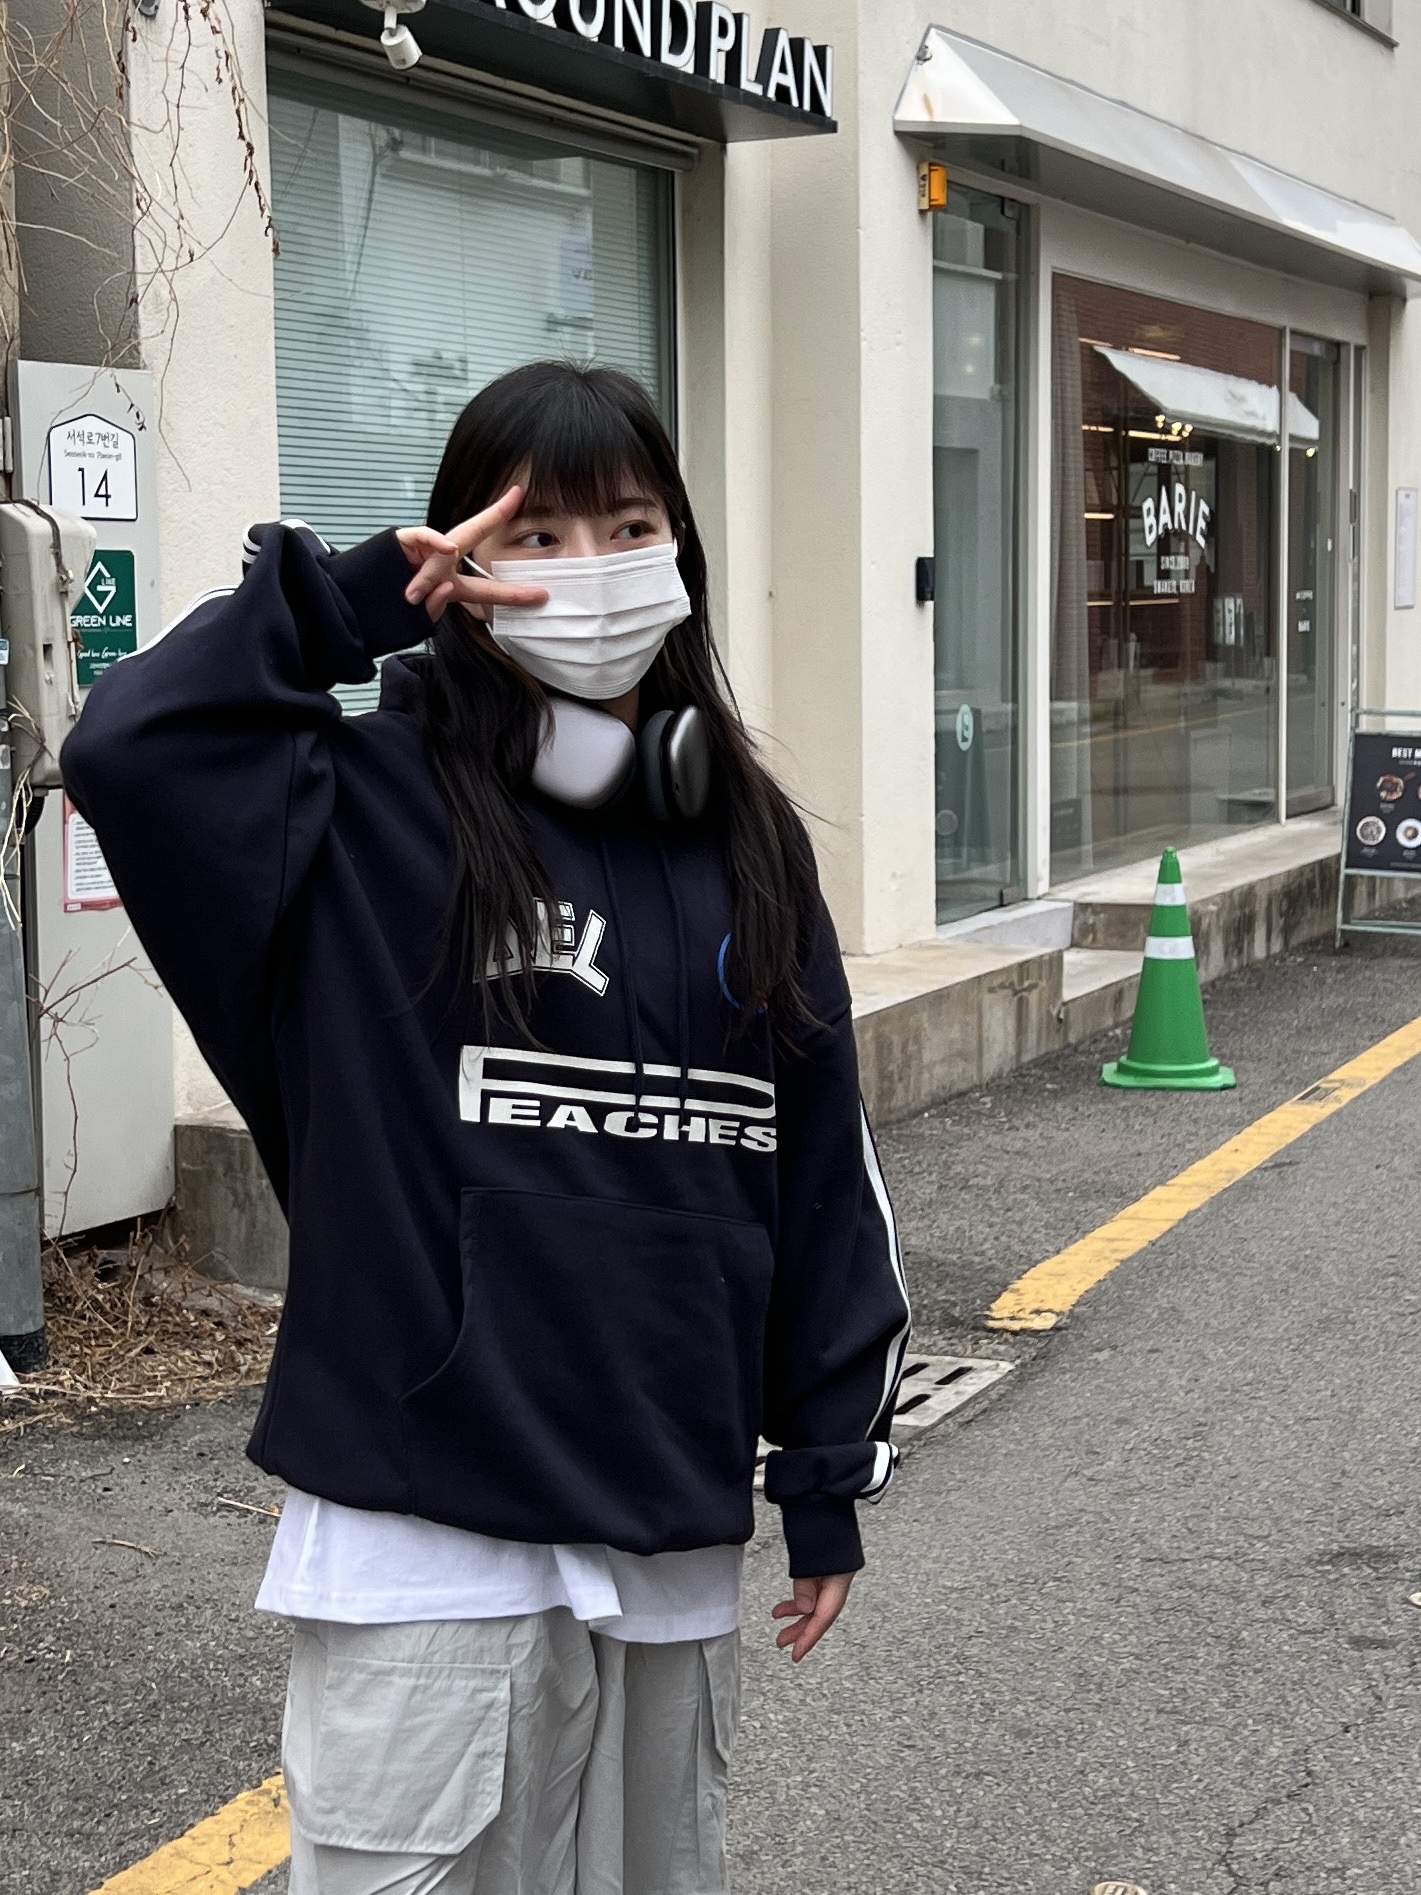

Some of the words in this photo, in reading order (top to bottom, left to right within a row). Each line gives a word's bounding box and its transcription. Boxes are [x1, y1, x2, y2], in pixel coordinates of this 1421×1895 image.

[66, 429, 119, 449] 서석로7번길
[78, 467, 112, 507] 14
[1142, 482, 1211, 550] BARIE
[70, 614, 107, 628] GREEN
[109, 614, 133, 628] LINE
[458, 1044, 778, 1153] PEACHES
